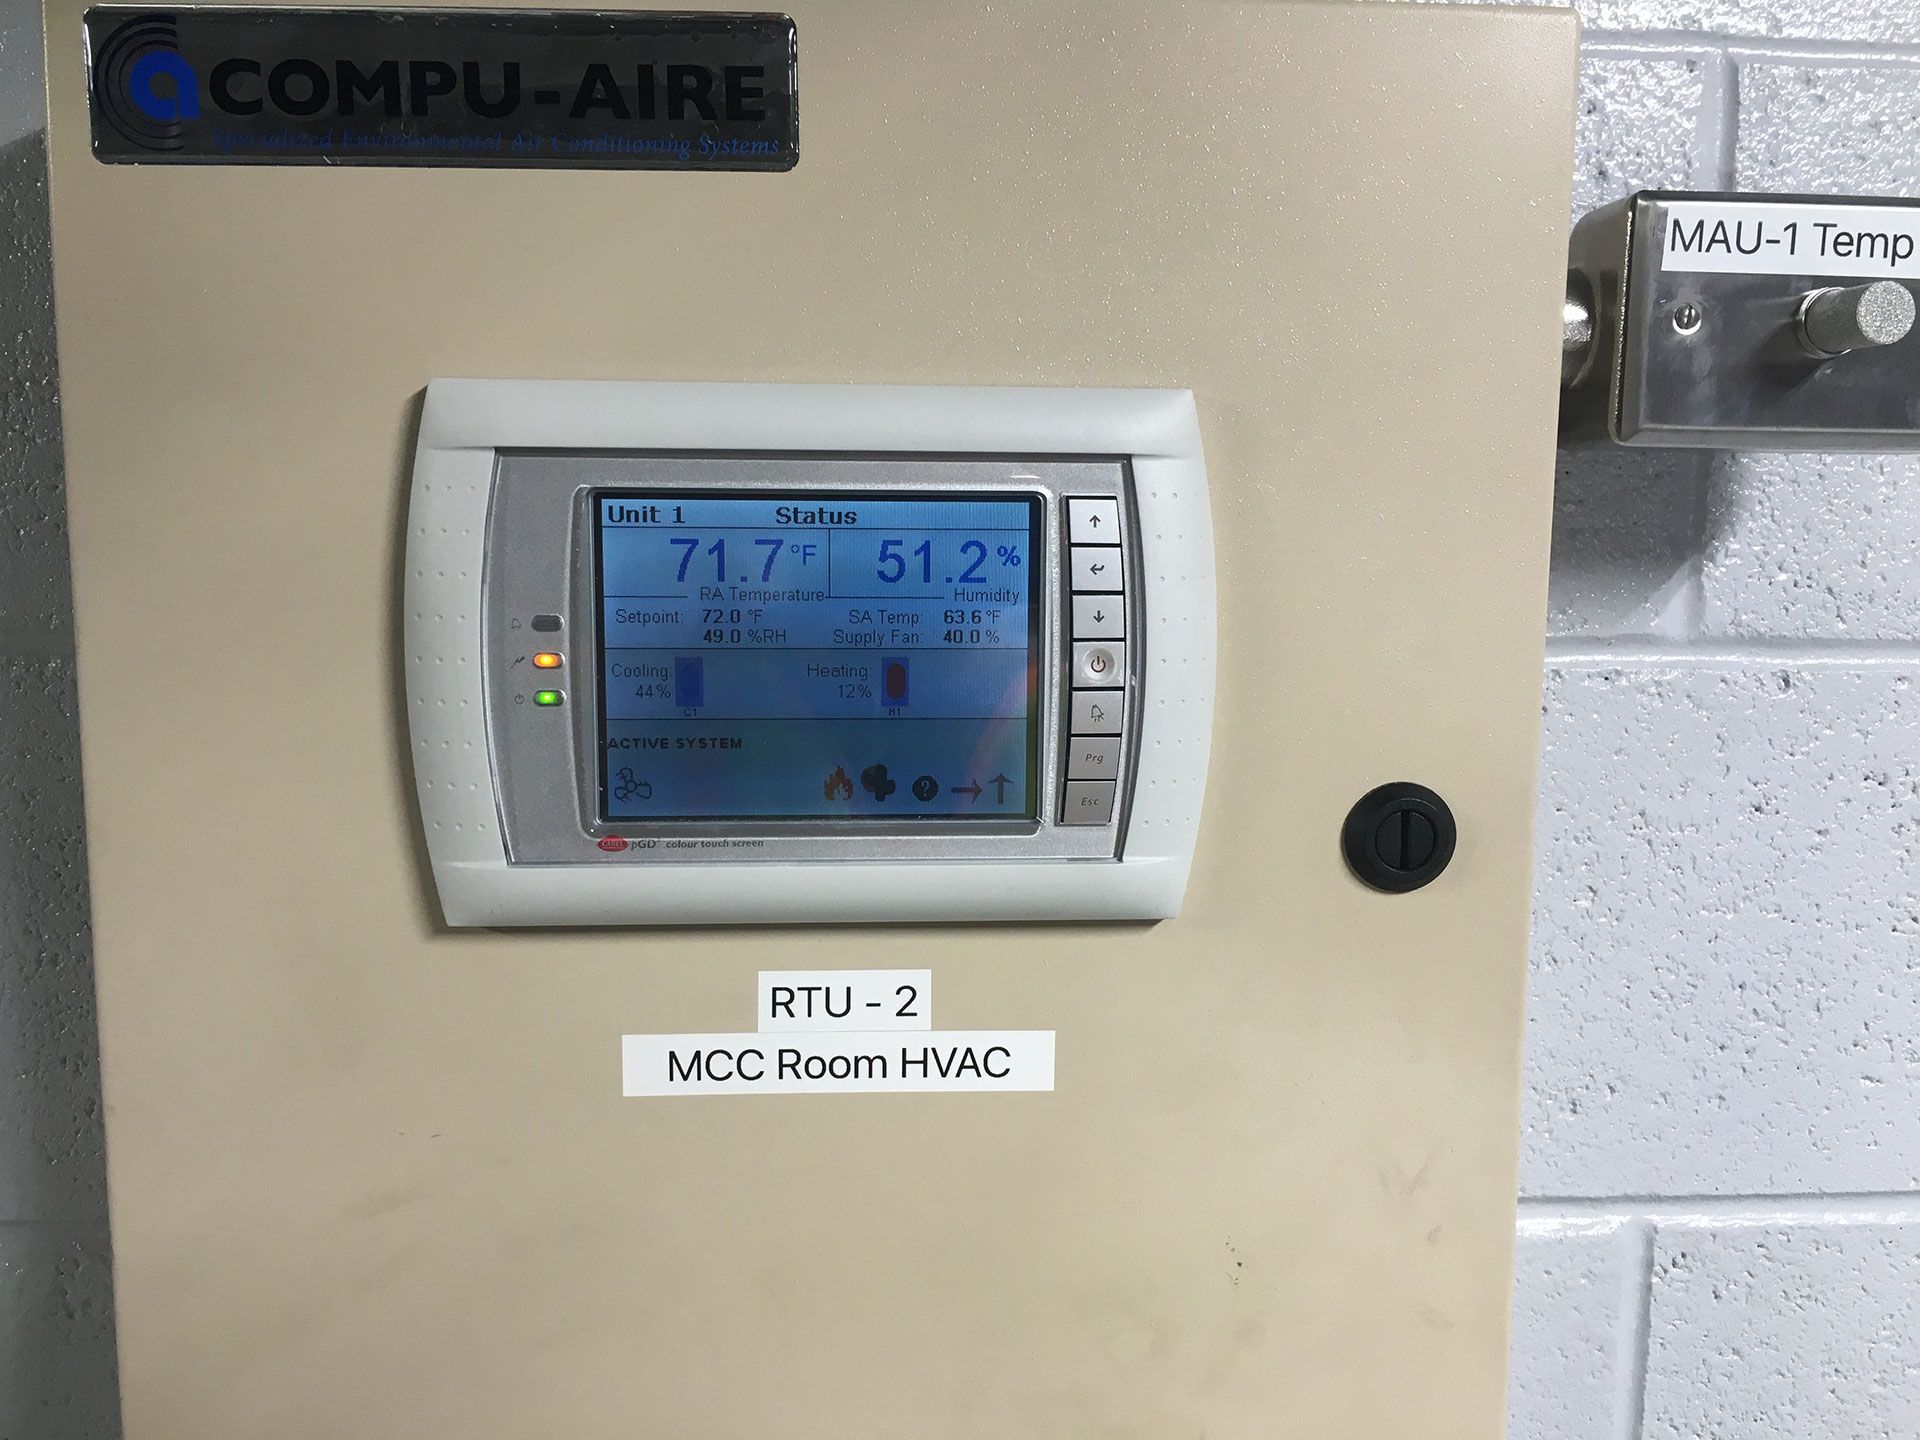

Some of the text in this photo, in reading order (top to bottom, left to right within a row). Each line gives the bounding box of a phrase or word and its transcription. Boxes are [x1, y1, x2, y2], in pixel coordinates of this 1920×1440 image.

[209, 58, 766, 121] COMPU-AIRE
[213, 128, 779, 160] Specialized Environmental Air Conditioning Systems
[1670, 218, 1915, 267] MAU-1 Temp
[607, 505, 686, 524] Unit 1
[775, 506, 858, 525] Status
[669, 538, 784, 583] 71.7
[876, 539, 1022, 584] 51.2 %
[700, 586, 825, 605] RA Temperature
[954, 587, 1020, 606] Humidity
[615, 608, 685, 627] Setpoint:
[702, 609, 741, 624] 72.0
[849, 610, 873, 625] SA
[877, 610, 924, 628] Temp:
[943, 609, 982, 625] 63.6
[702, 628, 787, 644] 49.0 %RH
[833, 629, 1000, 647] Supply Fan: 40.0 %
[611, 663, 673, 681] Cooling:
[807, 664, 872, 682] Heating:
[635, 684, 671, 699] 44%
[838, 685, 872, 699] 12%
[683, 707, 698, 717] C1
[888, 708, 902, 717] H1
[608, 737, 742, 750] ACTIVE SYSTEM
[1085, 753, 1104, 765] Prg
[1081, 797, 1100, 806] Esc
[665, 839, 699, 849] colour
[700, 838, 729, 848] touch
[770, 986, 852, 1018] RTU
[894, 985, 918, 1017] 2
[668, 1046, 1011, 1082] MCC Room HVAC
